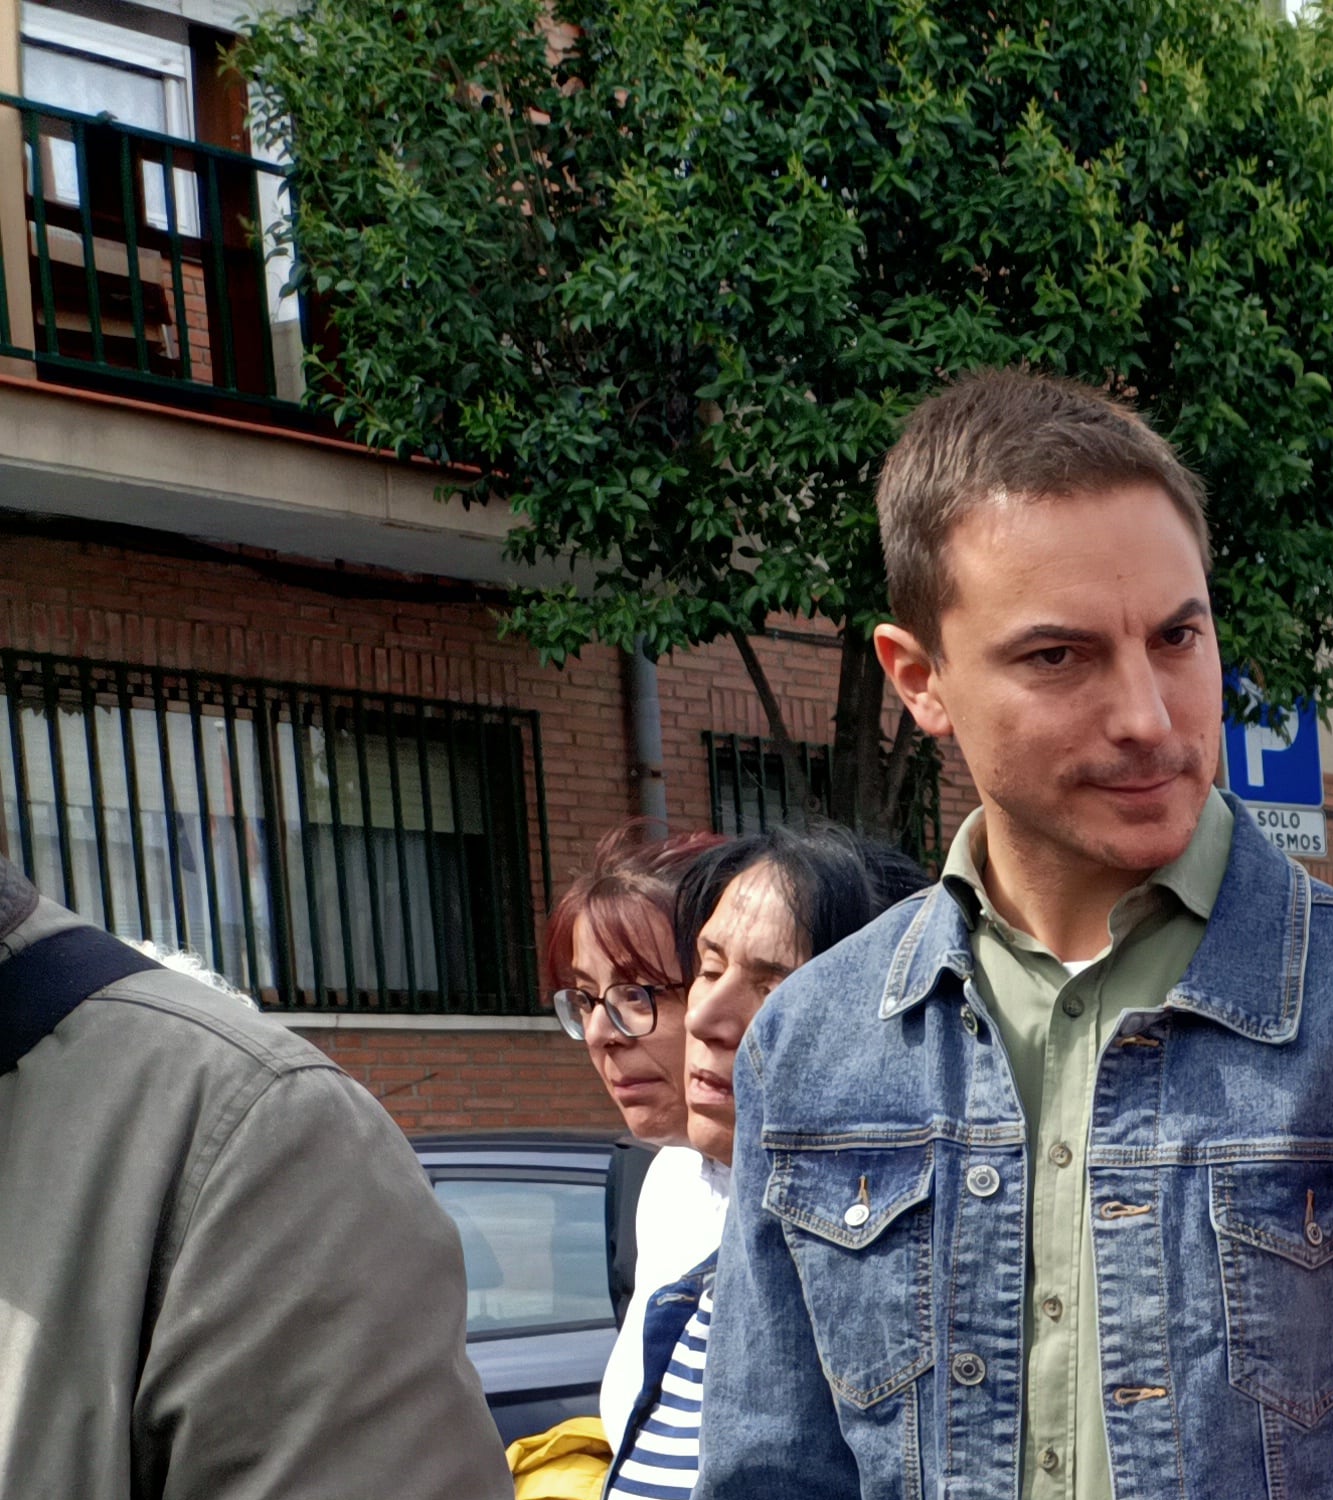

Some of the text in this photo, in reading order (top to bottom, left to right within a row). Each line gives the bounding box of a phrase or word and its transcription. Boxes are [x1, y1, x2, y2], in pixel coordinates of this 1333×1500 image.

[1240, 677, 1300, 787] P
[1257, 810, 1301, 829] SOLO
[1269, 832, 1322, 851] ISMOS
